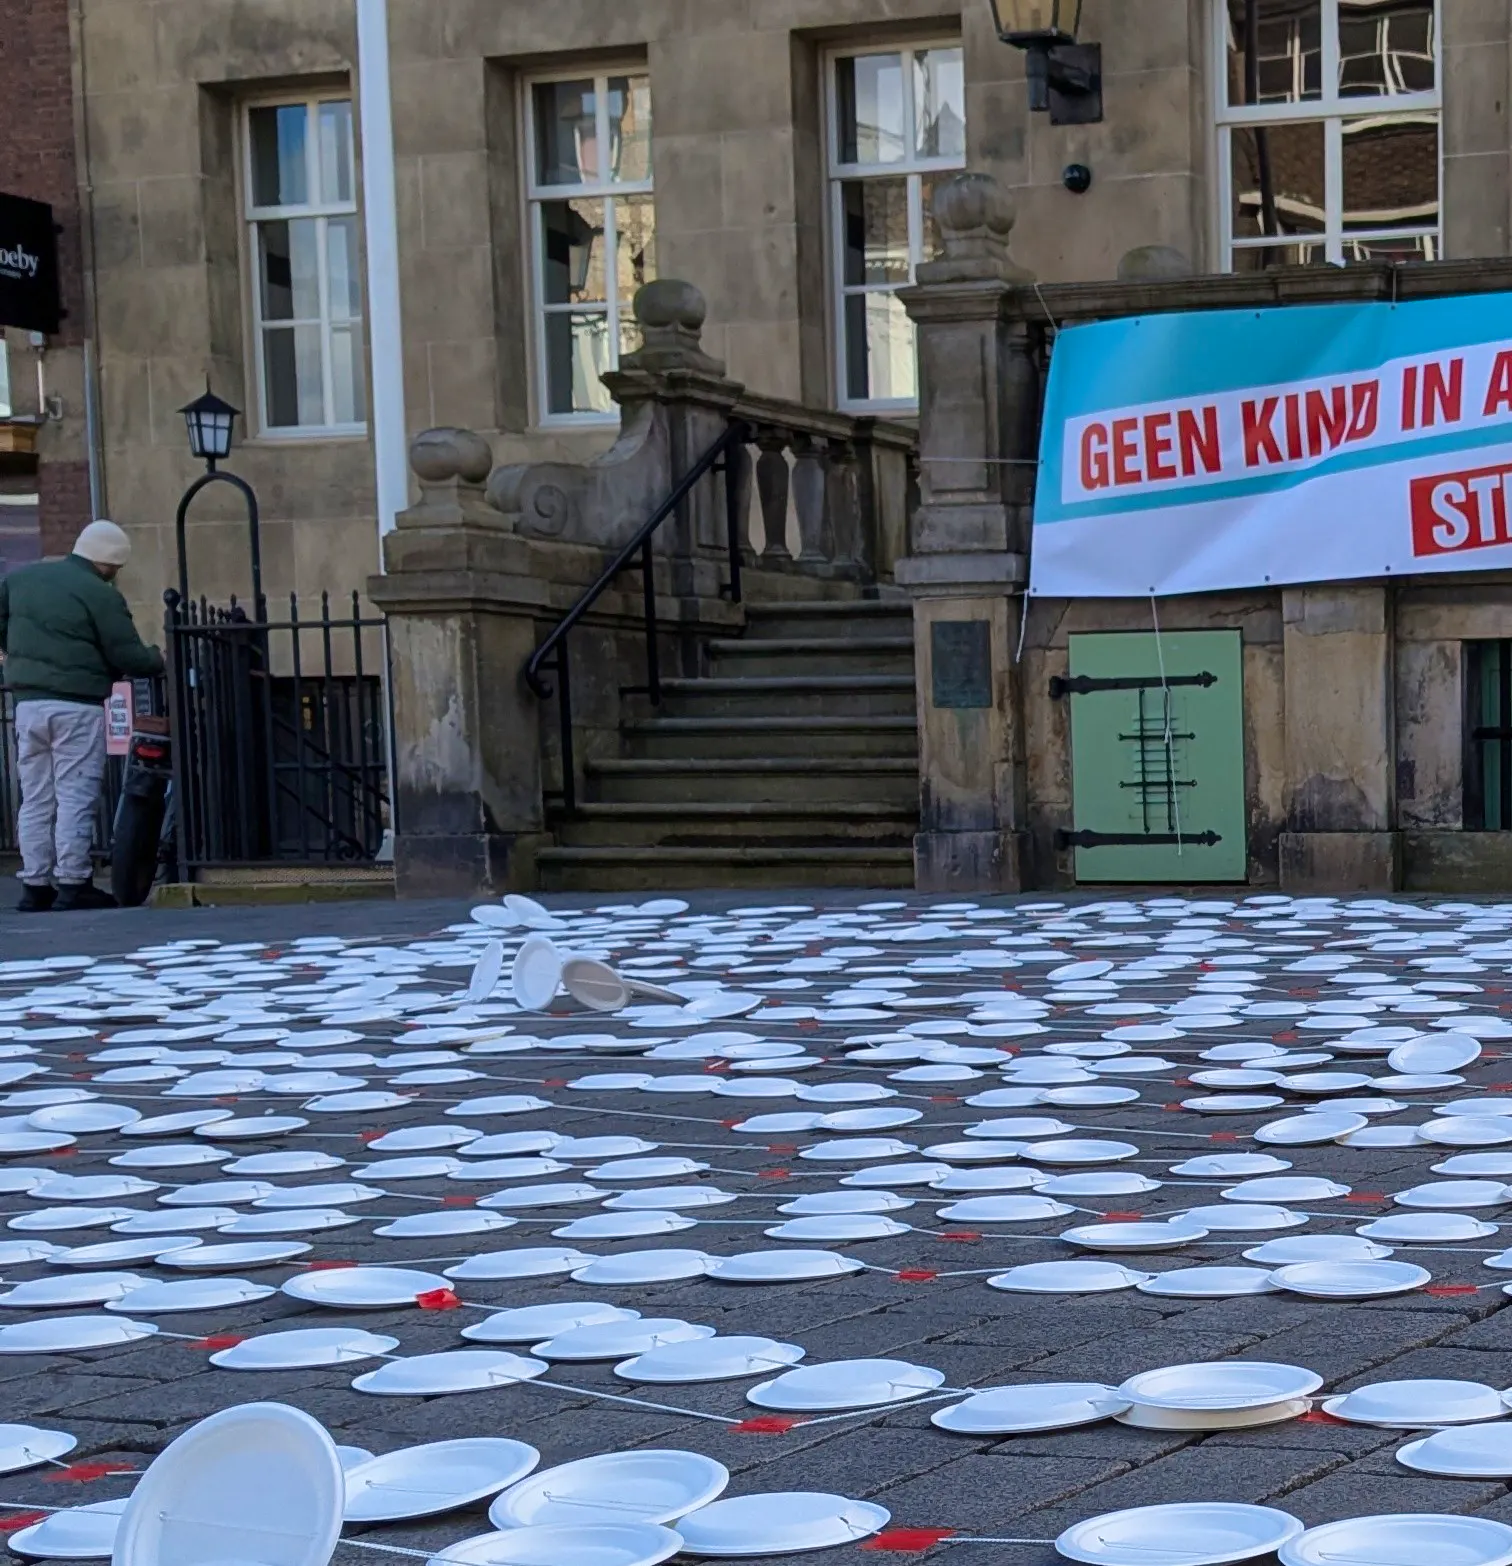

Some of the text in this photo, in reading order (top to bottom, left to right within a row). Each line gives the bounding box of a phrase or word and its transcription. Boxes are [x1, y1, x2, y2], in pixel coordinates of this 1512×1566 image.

[1080, 405, 1222, 491] GEEN
[1240, 378, 1379, 468] KIND
[1400, 357, 1465, 432] IN
